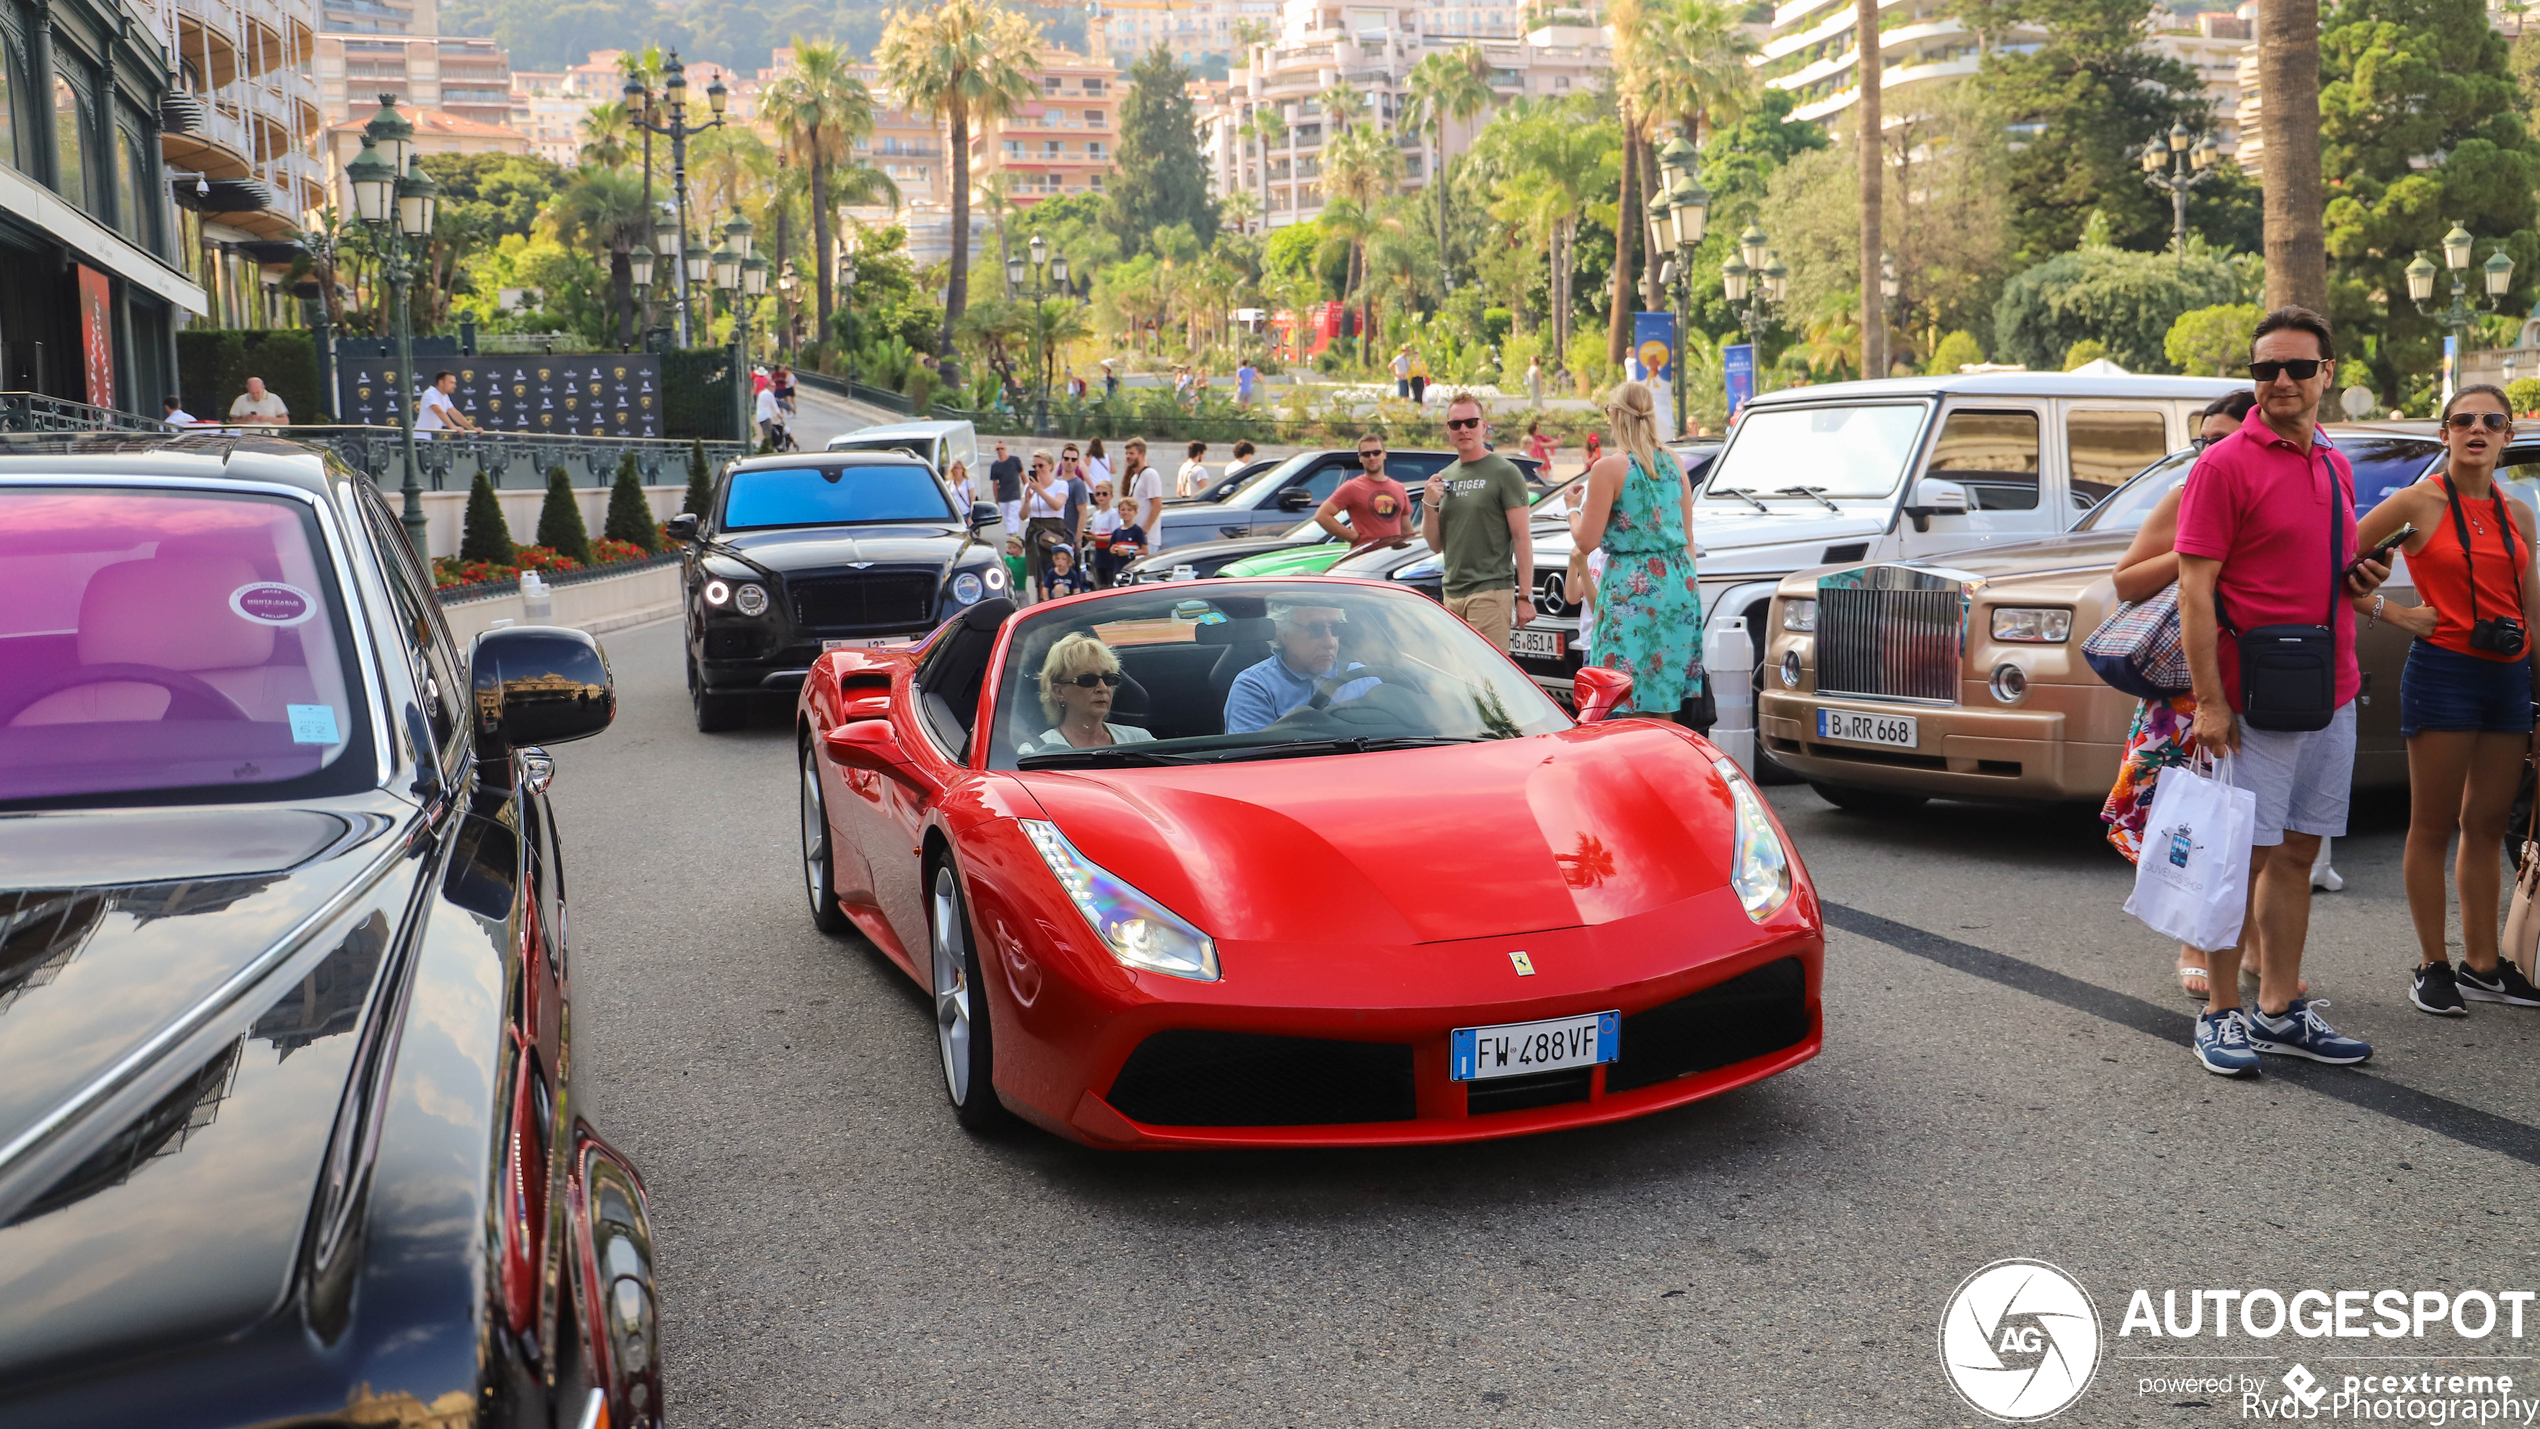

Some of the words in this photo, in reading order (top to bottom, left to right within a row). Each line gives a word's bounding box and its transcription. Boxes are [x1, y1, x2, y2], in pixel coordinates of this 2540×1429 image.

[1453, 479, 1486, 491] LFIGER
[1526, 633, 1545, 652] 851
[1547, 635, 1554, 653] A
[1832, 714, 1842, 736] B
[1852, 716, 1873, 740] RR
[1877, 719, 1909, 743] 668
[1478, 1036, 1509, 1069] FW
